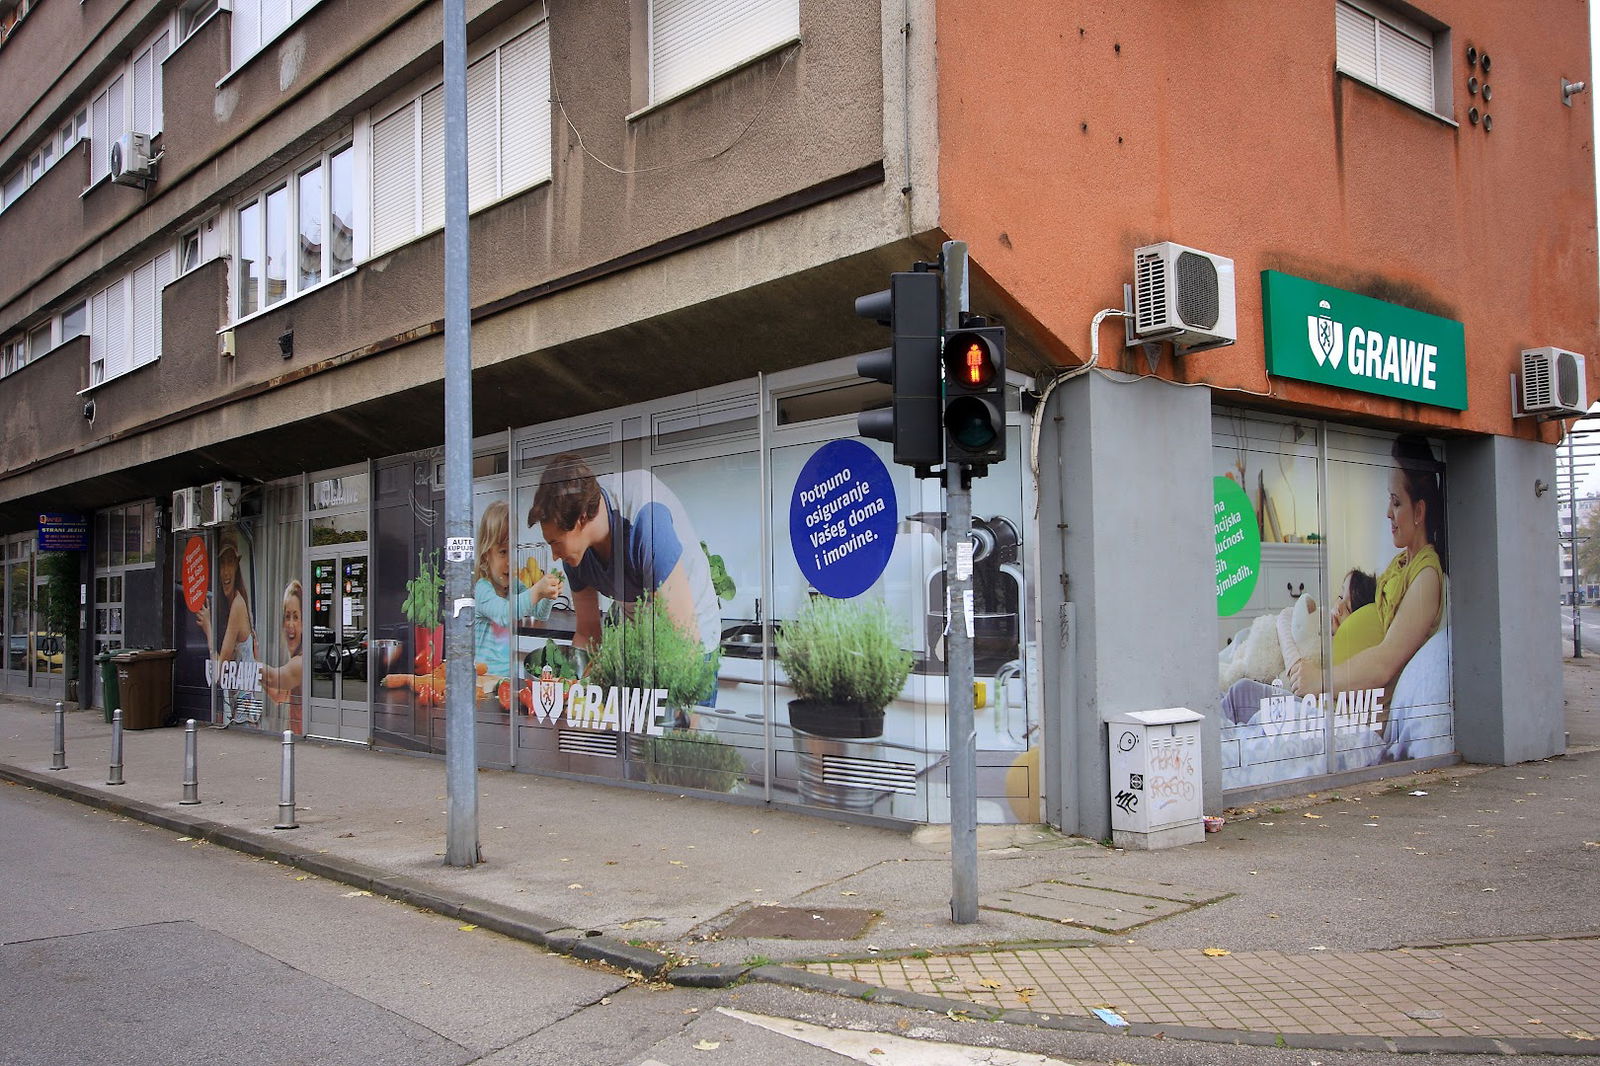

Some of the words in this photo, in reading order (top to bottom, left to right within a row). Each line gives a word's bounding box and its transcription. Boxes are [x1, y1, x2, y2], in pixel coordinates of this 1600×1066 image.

[1348, 326, 1438, 390] GRAWE
[800, 468, 851, 507] Potpuno
[805, 481, 870, 527] osiguranje
[1215, 501, 1225, 514] na
[810, 520, 847, 549] Vašeg
[848, 497, 885, 527] doma
[1215, 512, 1241, 534] ncijska
[814, 553, 822, 570] i
[823, 528, 879, 567] imovine.
[220, 660, 263, 693] GRAWE
[567, 683, 669, 736] GRAWE
